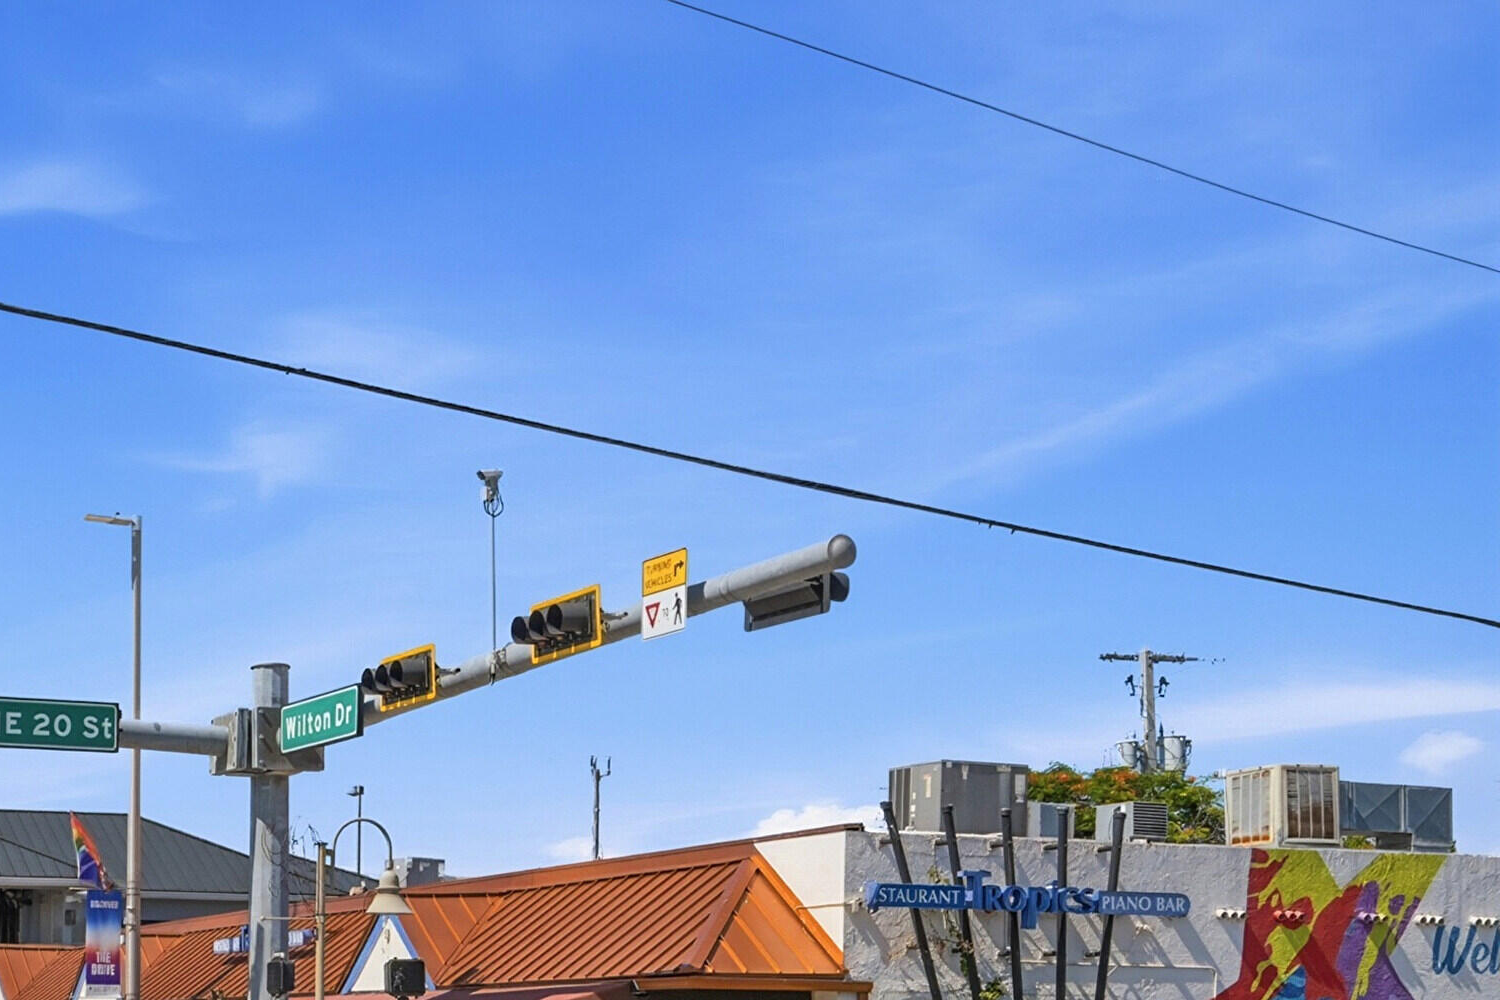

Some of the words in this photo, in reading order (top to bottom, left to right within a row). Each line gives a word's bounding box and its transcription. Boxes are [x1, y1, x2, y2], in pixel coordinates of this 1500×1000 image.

[32, 713, 72, 737] 20
[82, 715, 112, 739] St
[285, 711, 331, 740] Wilton
[335, 703, 353, 727] Dr
[1102, 895, 1152, 911] PIANO
[1156, 897, 1186, 912] BAR
[96, 952, 111, 963] THE
